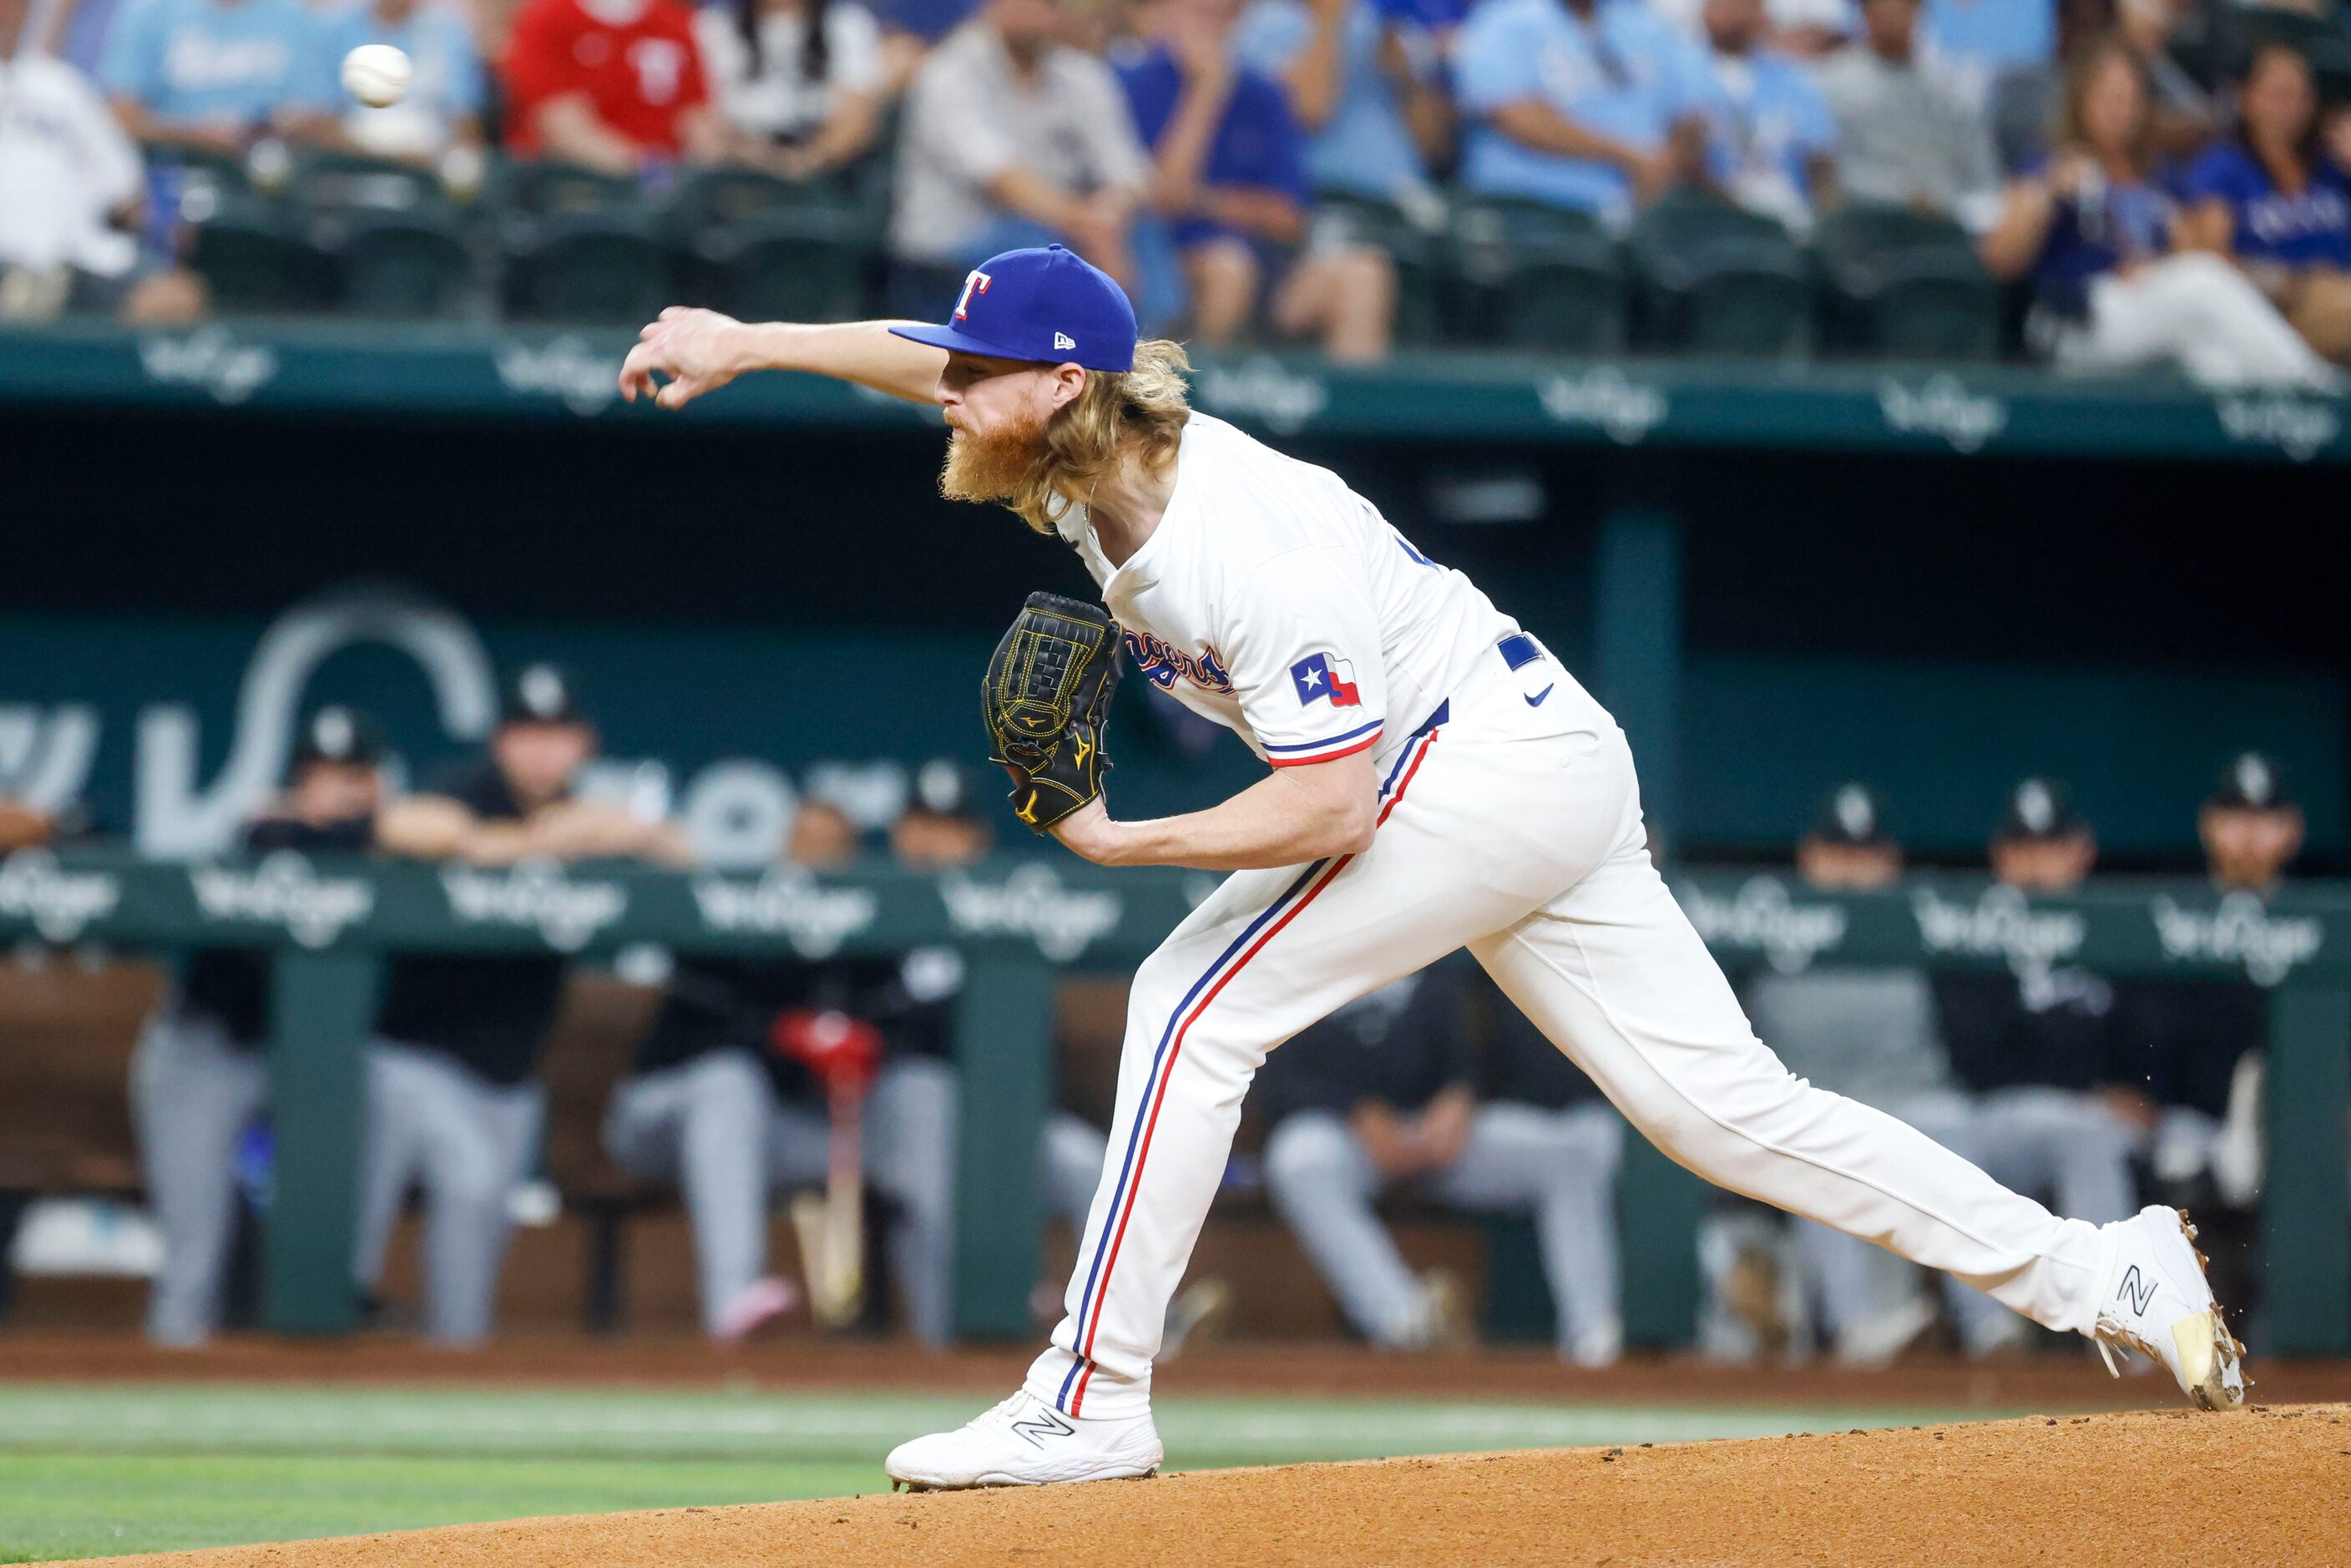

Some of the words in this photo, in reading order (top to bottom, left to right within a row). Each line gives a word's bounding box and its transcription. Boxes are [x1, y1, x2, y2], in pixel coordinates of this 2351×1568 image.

[955, 270, 992, 321] T
[1126, 630, 1236, 695] ngers
[1011, 1408, 1074, 1450] N
